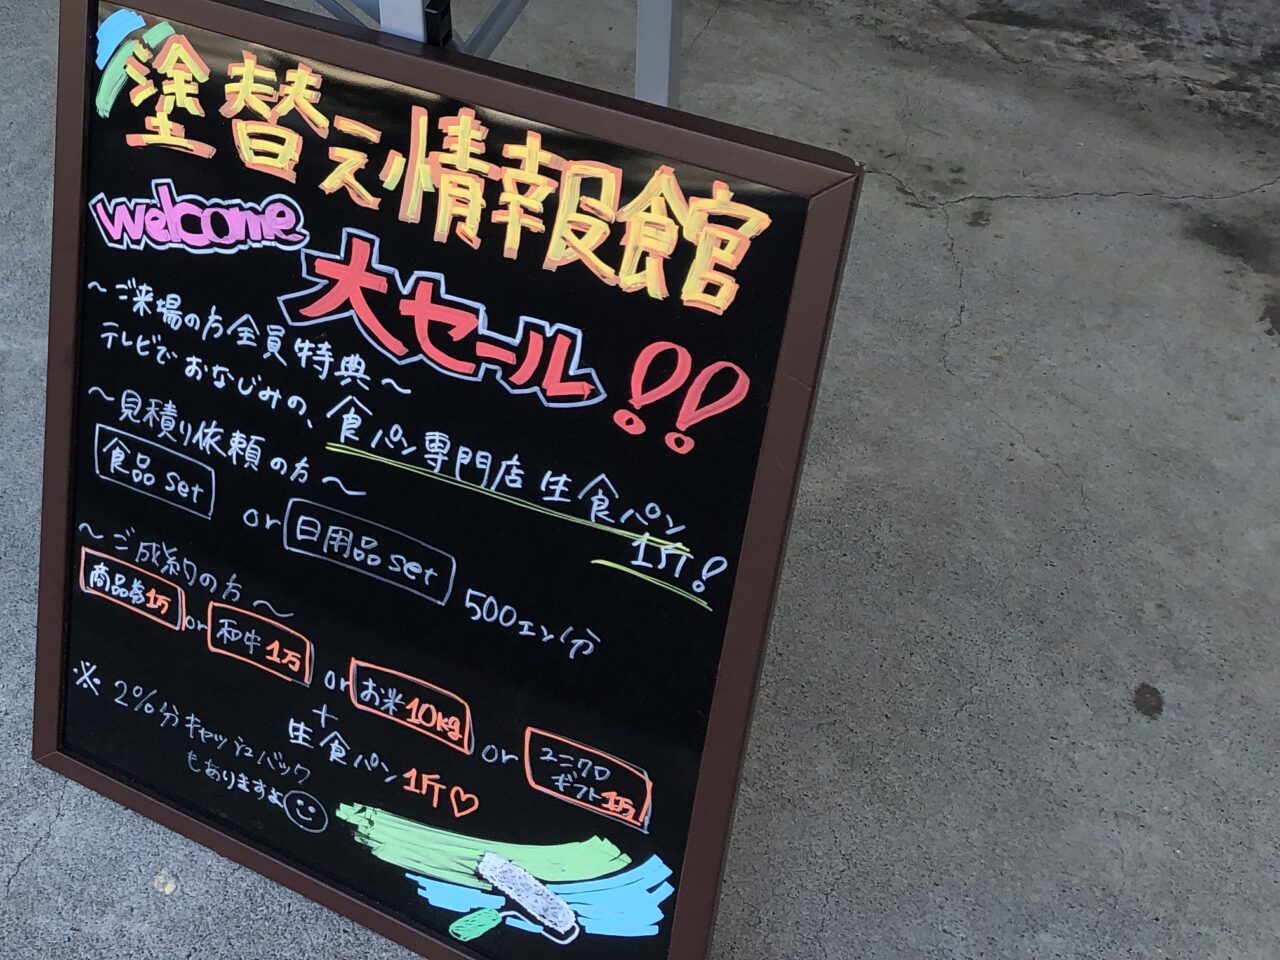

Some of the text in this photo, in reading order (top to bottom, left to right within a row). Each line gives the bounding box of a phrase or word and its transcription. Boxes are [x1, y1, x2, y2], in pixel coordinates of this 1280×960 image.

[125, 33, 772, 315] 塗替え情報館
